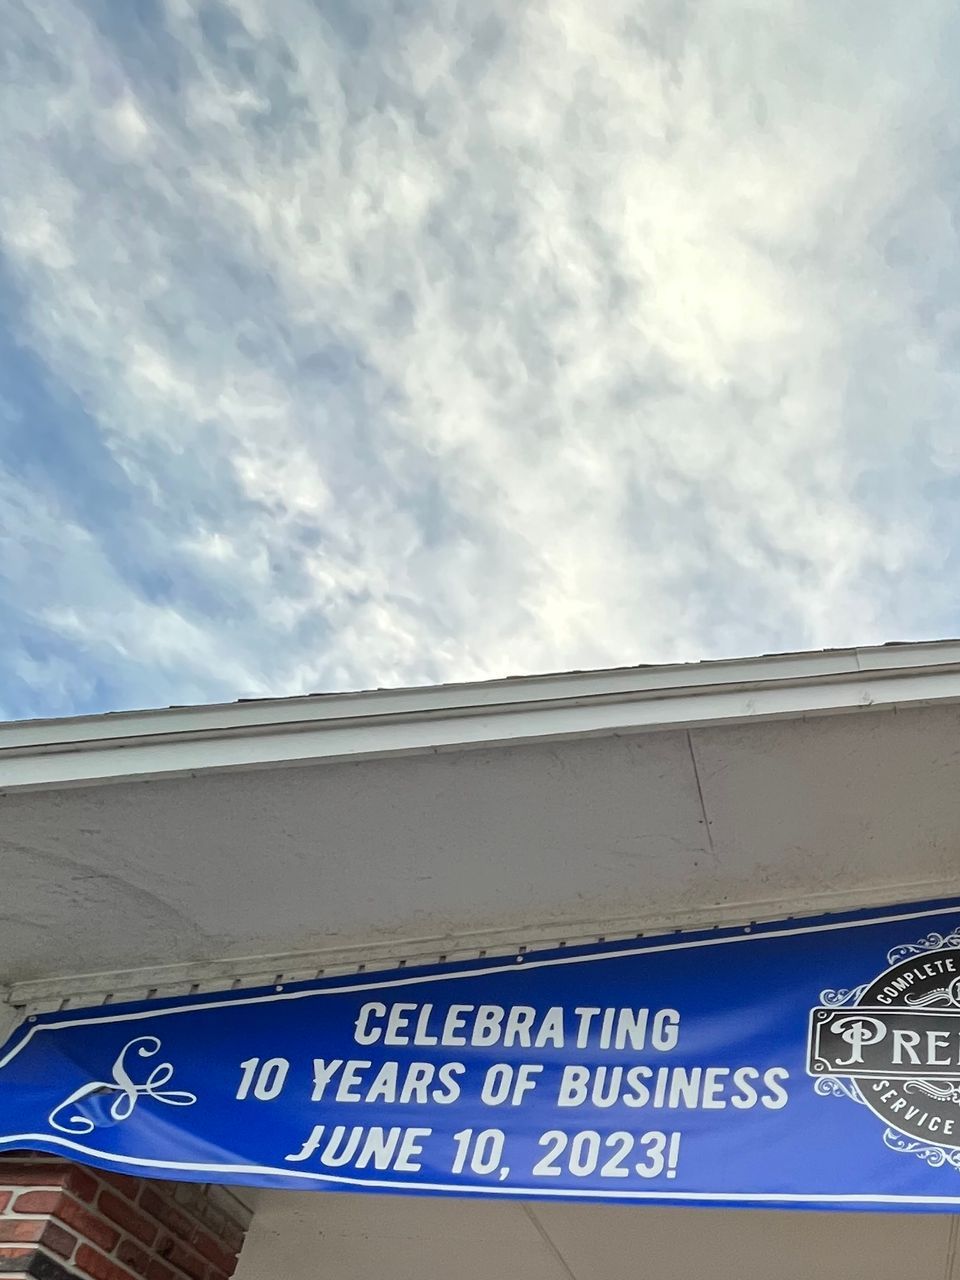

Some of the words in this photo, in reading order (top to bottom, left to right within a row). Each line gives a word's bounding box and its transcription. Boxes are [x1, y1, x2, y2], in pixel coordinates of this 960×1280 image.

[876, 958, 956, 1005] COMPLETE
[354, 1002, 681, 1052] CELEBRATING
[236, 1057, 290, 1101] 10
[311, 1058, 466, 1105] YEARS
[481, 1063, 544, 1107] OF
[557, 1065, 790, 1110] BUSINESS
[872, 1079, 955, 1135] SERVICE
[285, 1125, 433, 1172] JUNE
[452, 1128, 510, 1181] 10,
[532, 1130, 682, 1180] 2023!
